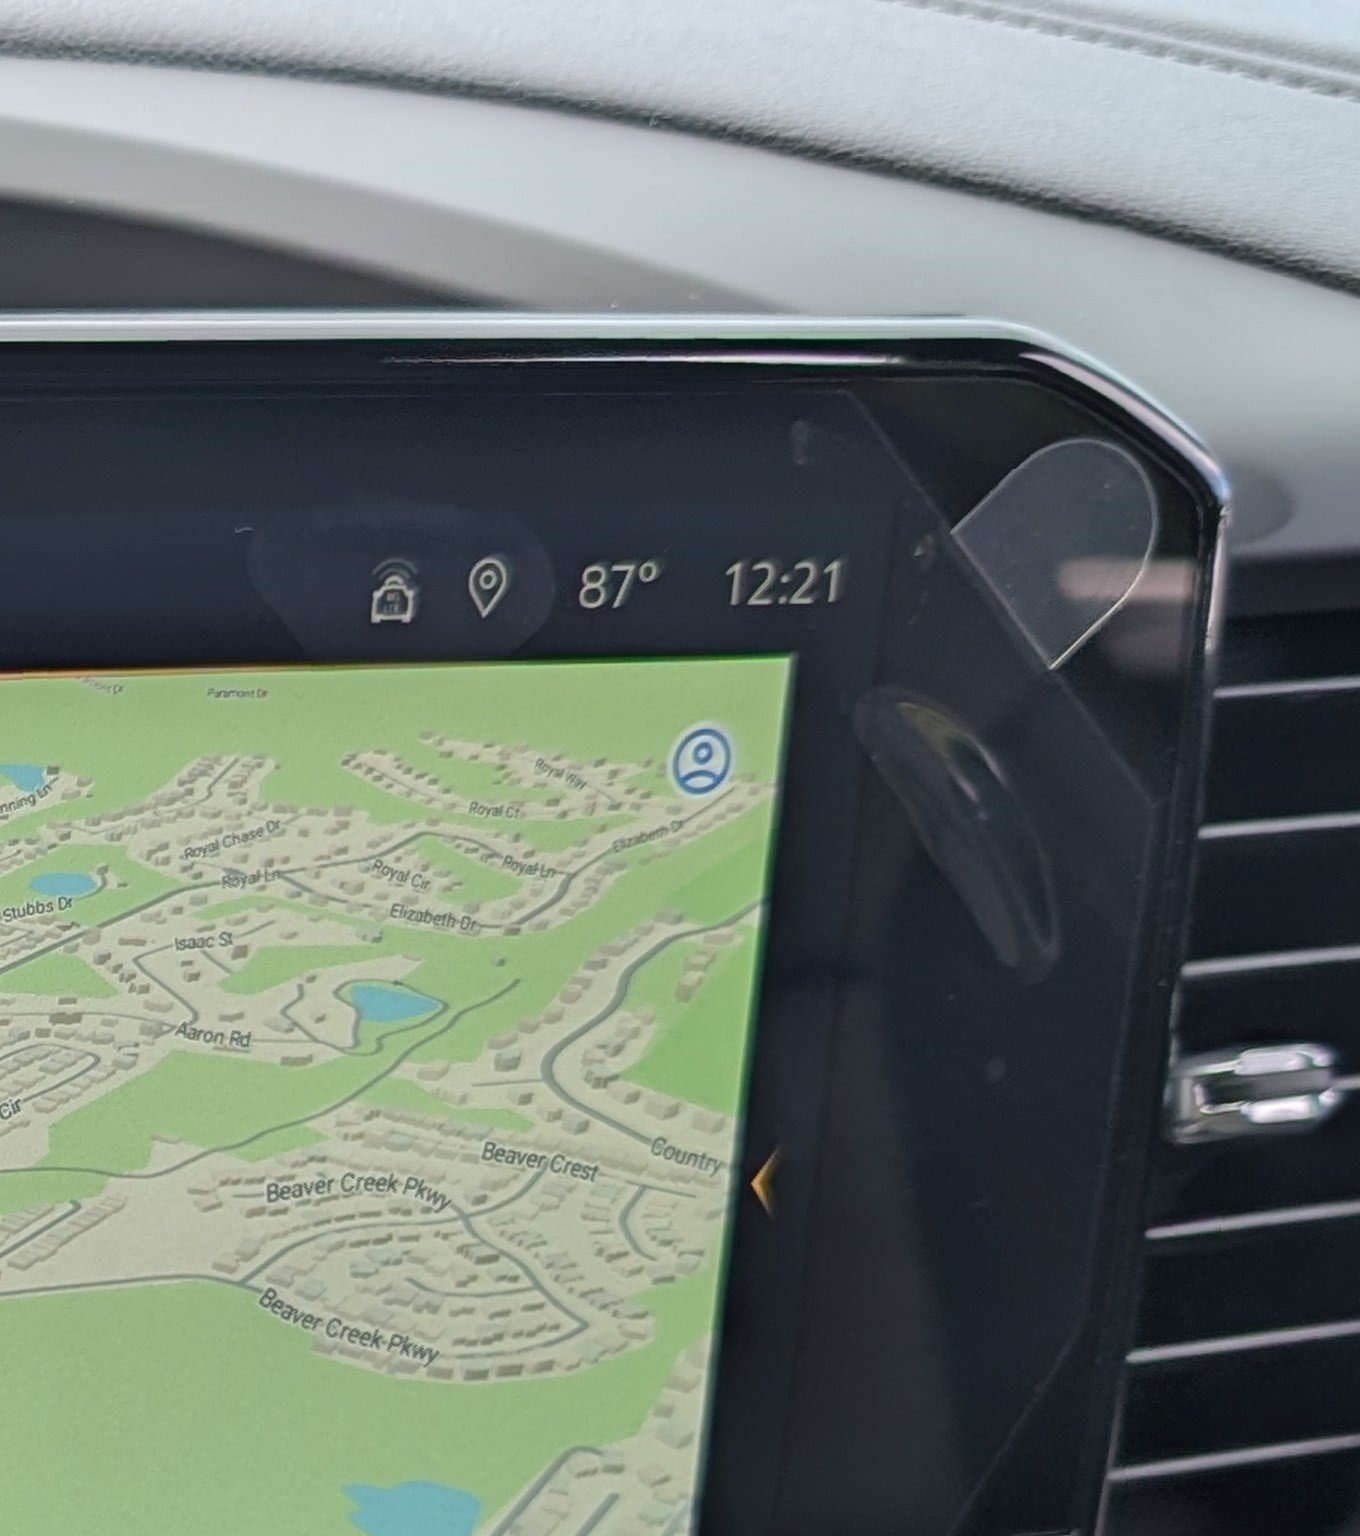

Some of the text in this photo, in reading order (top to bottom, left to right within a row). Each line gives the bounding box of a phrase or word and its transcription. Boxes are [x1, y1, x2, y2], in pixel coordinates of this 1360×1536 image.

[725, 558, 847, 608] 12:21
[468, 801, 504, 819] Royal
[373, 859, 410, 884] Royal
[503, 854, 540, 877] Royal
[2, 896, 74, 923] Stubbs Dr
[390, 902, 478, 931] Elizabeth Dr
[176, 1022, 251, 1048] Aaron Rd
[481, 1141, 598, 1182] Beaver Crest
[650, 1136, 723, 1177] Country
[266, 1174, 451, 1213] Beaver Creek Pkwy
[258, 1287, 440, 1365] Beaver Creek Pkwy
